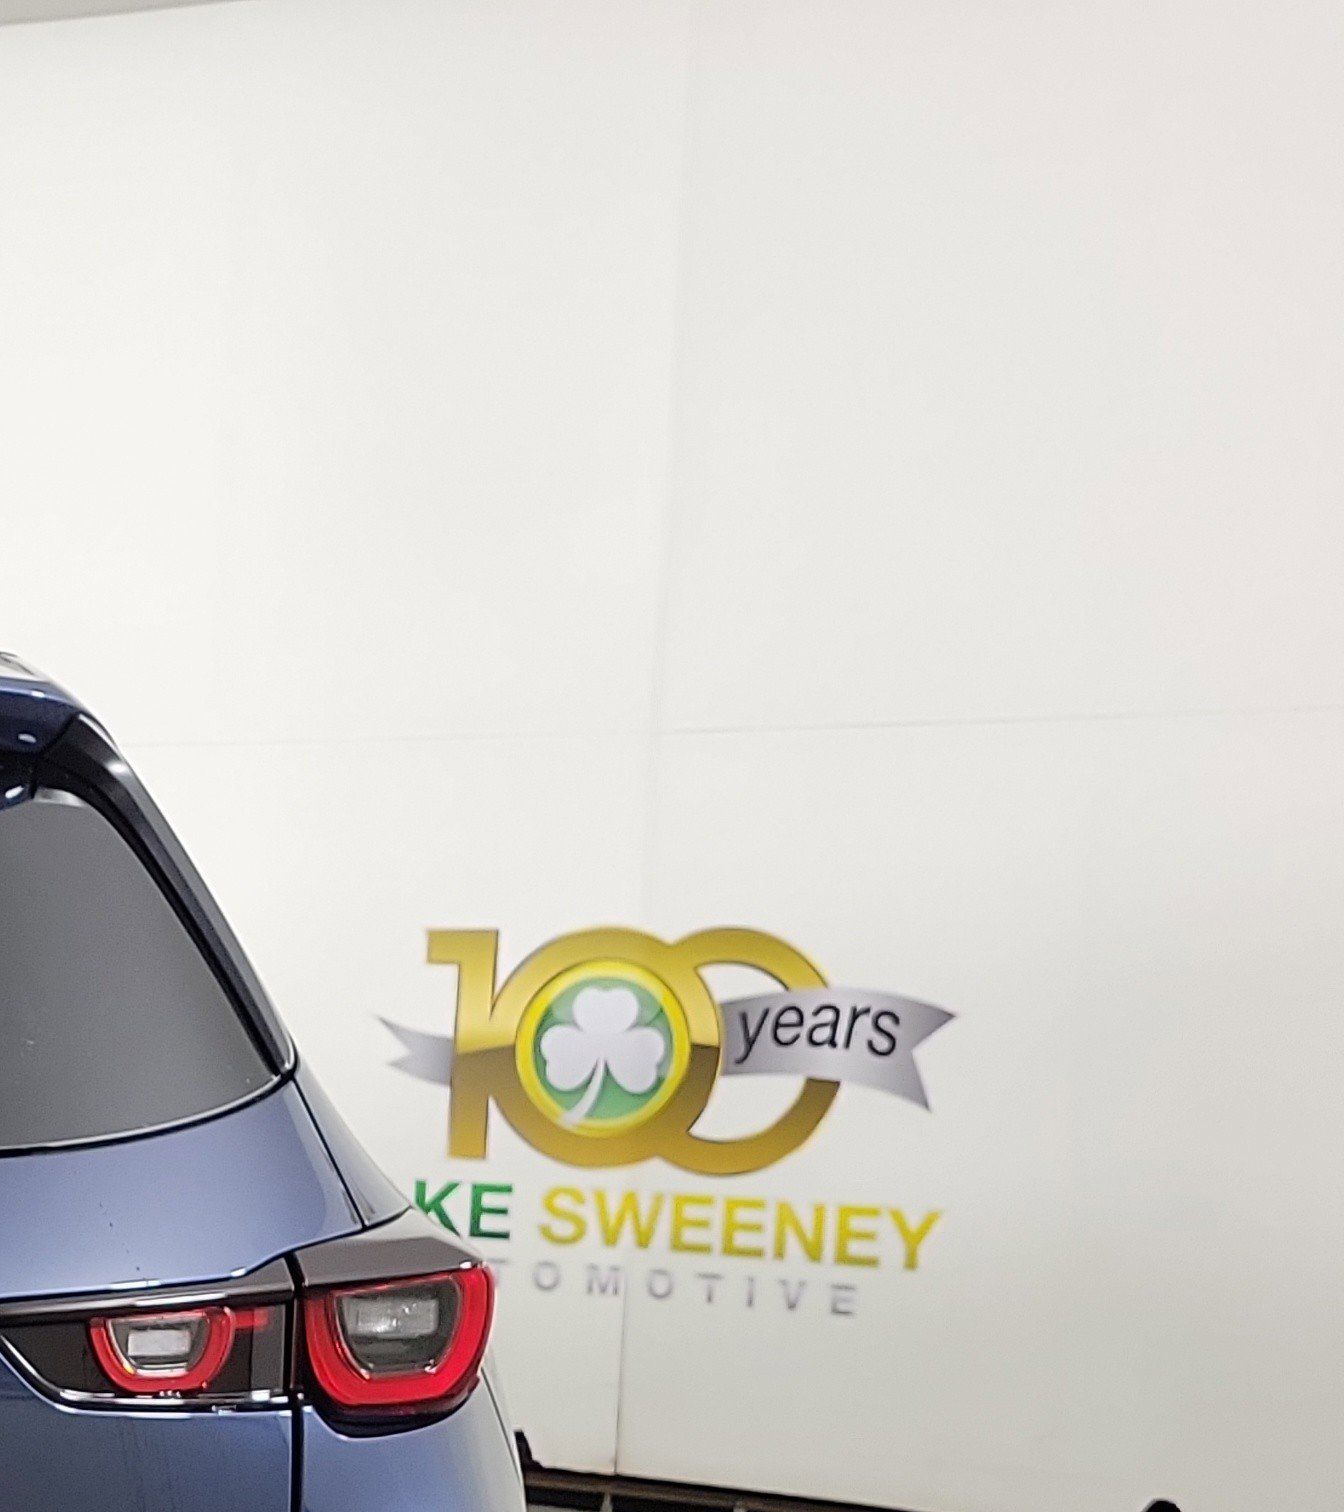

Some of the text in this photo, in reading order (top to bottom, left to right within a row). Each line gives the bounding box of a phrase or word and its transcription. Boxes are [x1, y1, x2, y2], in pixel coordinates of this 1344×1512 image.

[734, 1002, 902, 1065] years
[538, 1184, 943, 1272] SWEENEY
[488, 1257, 860, 1317] OMOTIVE
